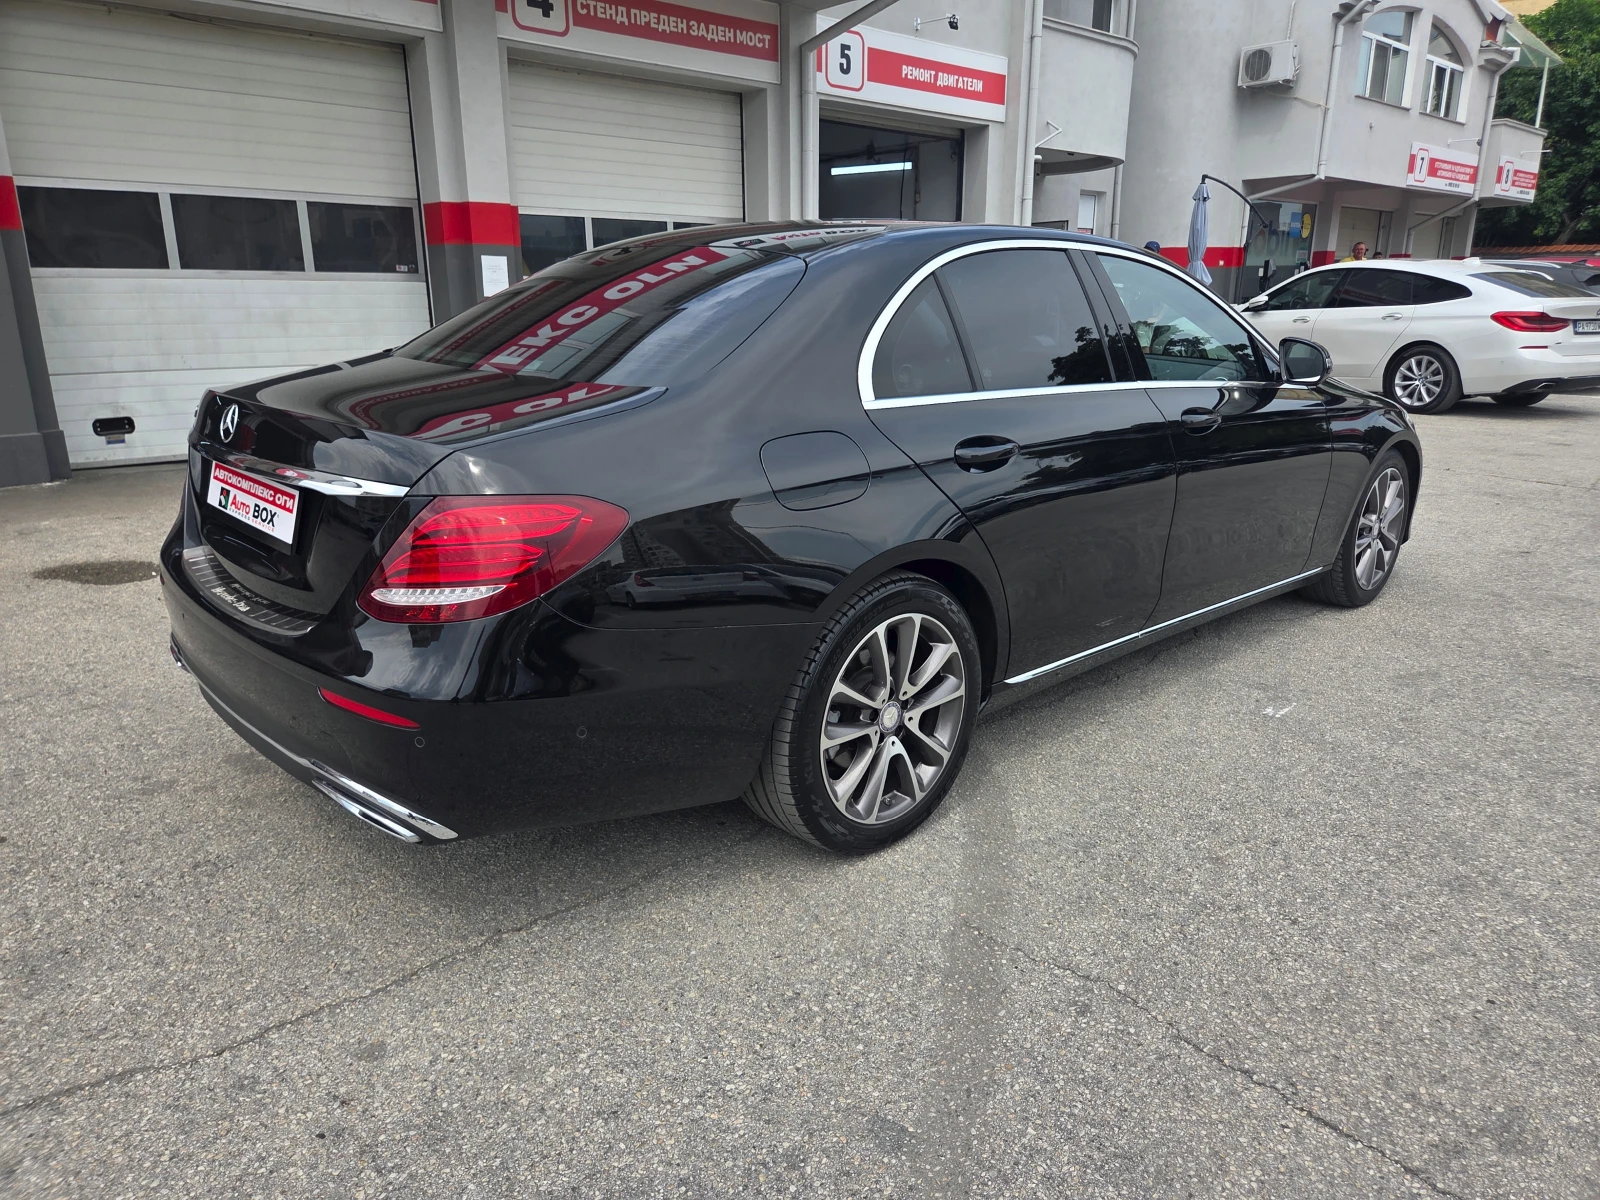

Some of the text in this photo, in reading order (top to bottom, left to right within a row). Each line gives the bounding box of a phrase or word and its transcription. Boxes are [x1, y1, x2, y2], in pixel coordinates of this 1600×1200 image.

[577, 0, 771, 49] СТЕНД ПРЕДЕН ЗАДЕН МОСТ
[839, 43, 852, 75] 5
[902, 65, 983, 92] РЕМОНТ ДВИГАТЕЛИ
[1418, 156, 1425, 174] 7
[214, 467, 294, 510] АВТОКОМПЛЕКС ОГИ
[229, 507, 275, 532] EXPRESS SERVICE
[252, 503, 277, 527] BOX
